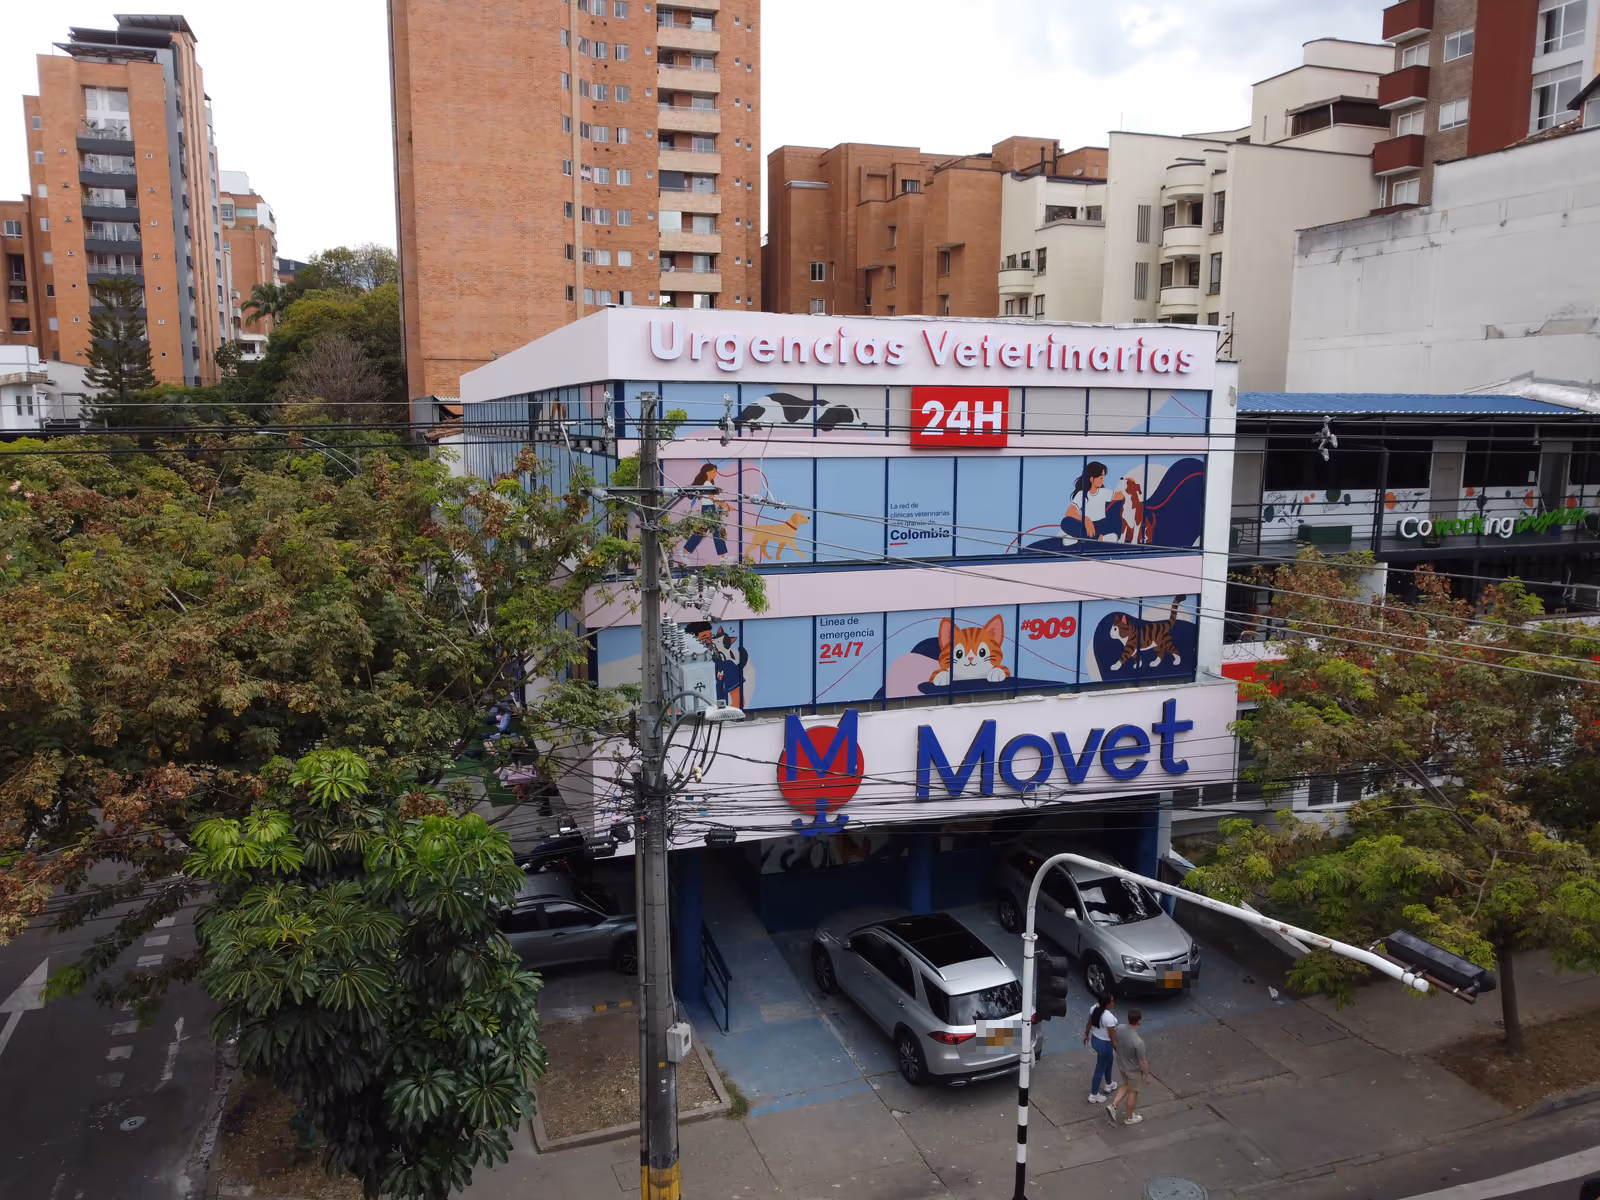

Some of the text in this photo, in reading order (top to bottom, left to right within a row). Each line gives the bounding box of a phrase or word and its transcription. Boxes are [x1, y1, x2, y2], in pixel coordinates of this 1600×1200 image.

[649, 320, 1196, 374] Urgencias Veterinarias
[920, 399, 1003, 436] 24H
[890, 527, 950, 541] Colombia
[1400, 512, 1514, 538] Coworking
[847, 616, 859, 625] de
[1020, 615, 1077, 640] #909
[820, 628, 875, 640] emergencia
[820, 641, 864, 659] 24/7
[916, 698, 1194, 801] Movet
